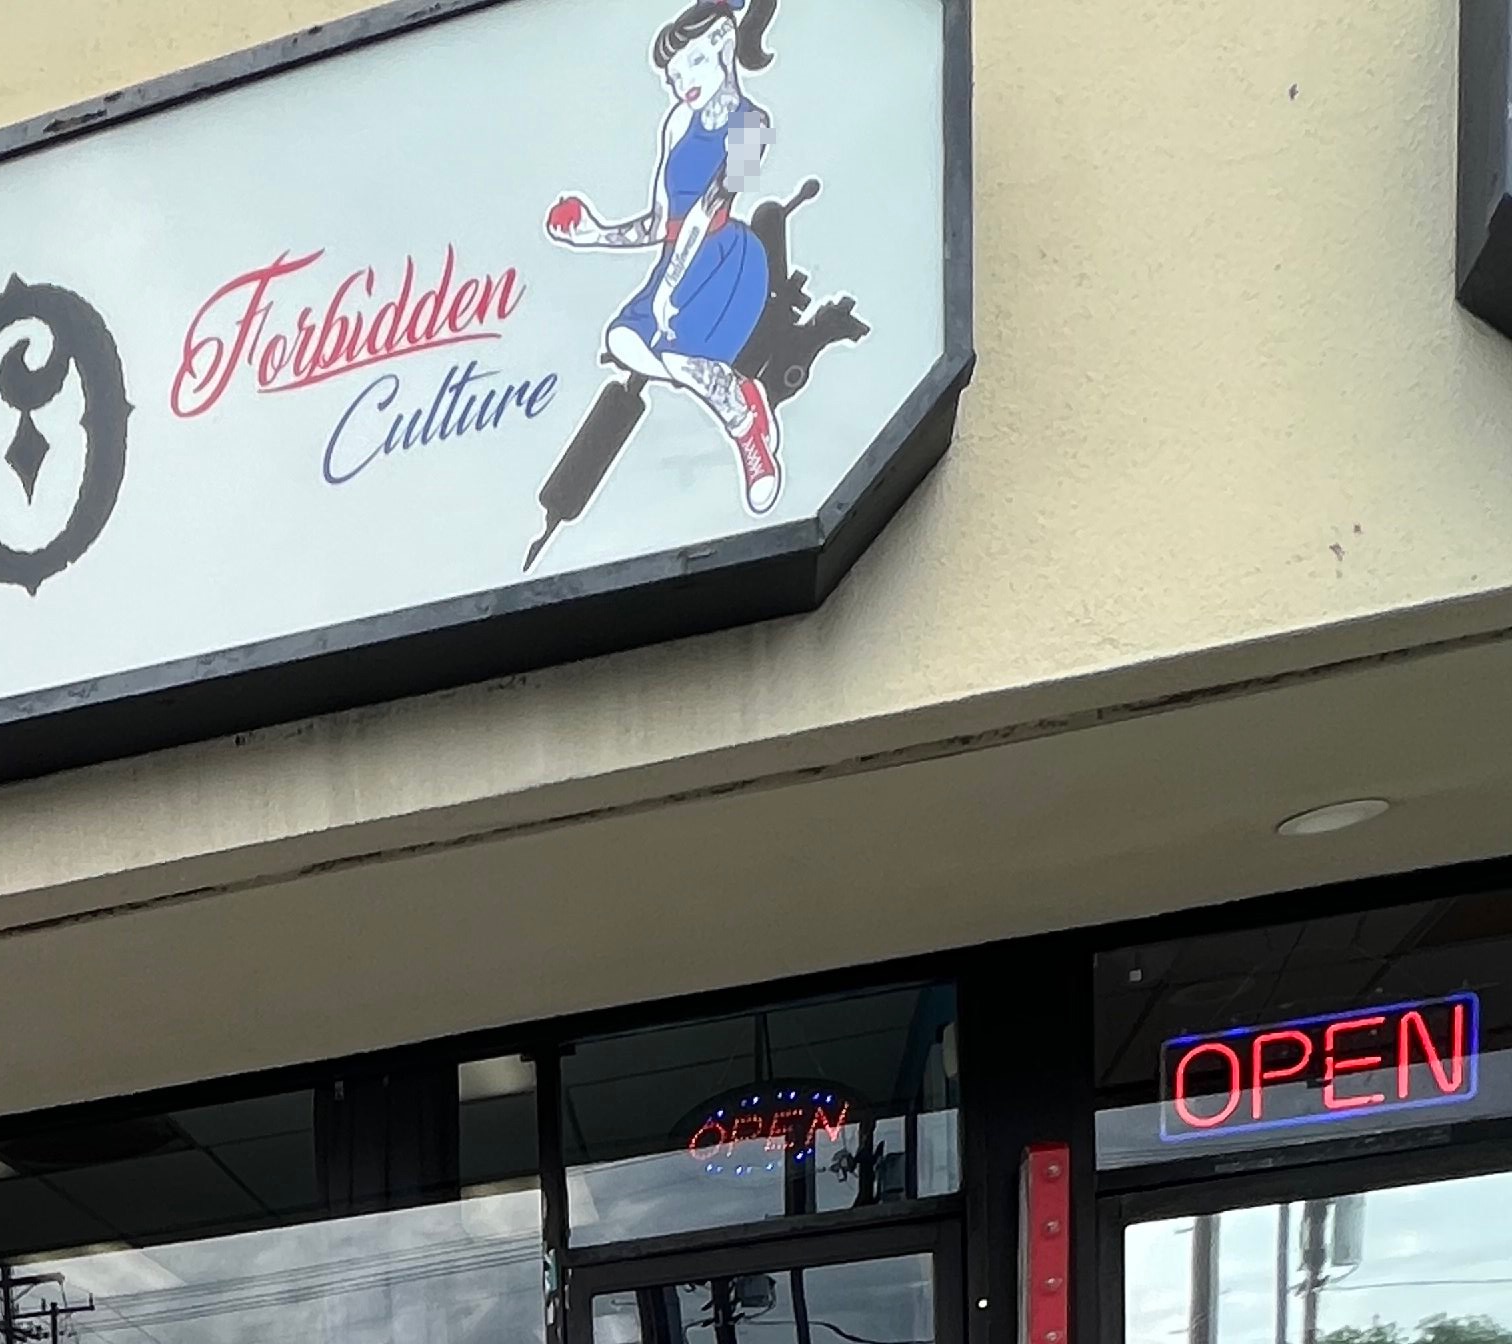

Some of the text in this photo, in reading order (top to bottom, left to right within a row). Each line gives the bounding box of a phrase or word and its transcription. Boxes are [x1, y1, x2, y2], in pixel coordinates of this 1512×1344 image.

[170, 242, 526, 418] Forbidden
[322, 360, 559, 485] Culture
[1175, 1004, 1464, 1128] OPEN
[689, 1102, 849, 1160] OPEN
